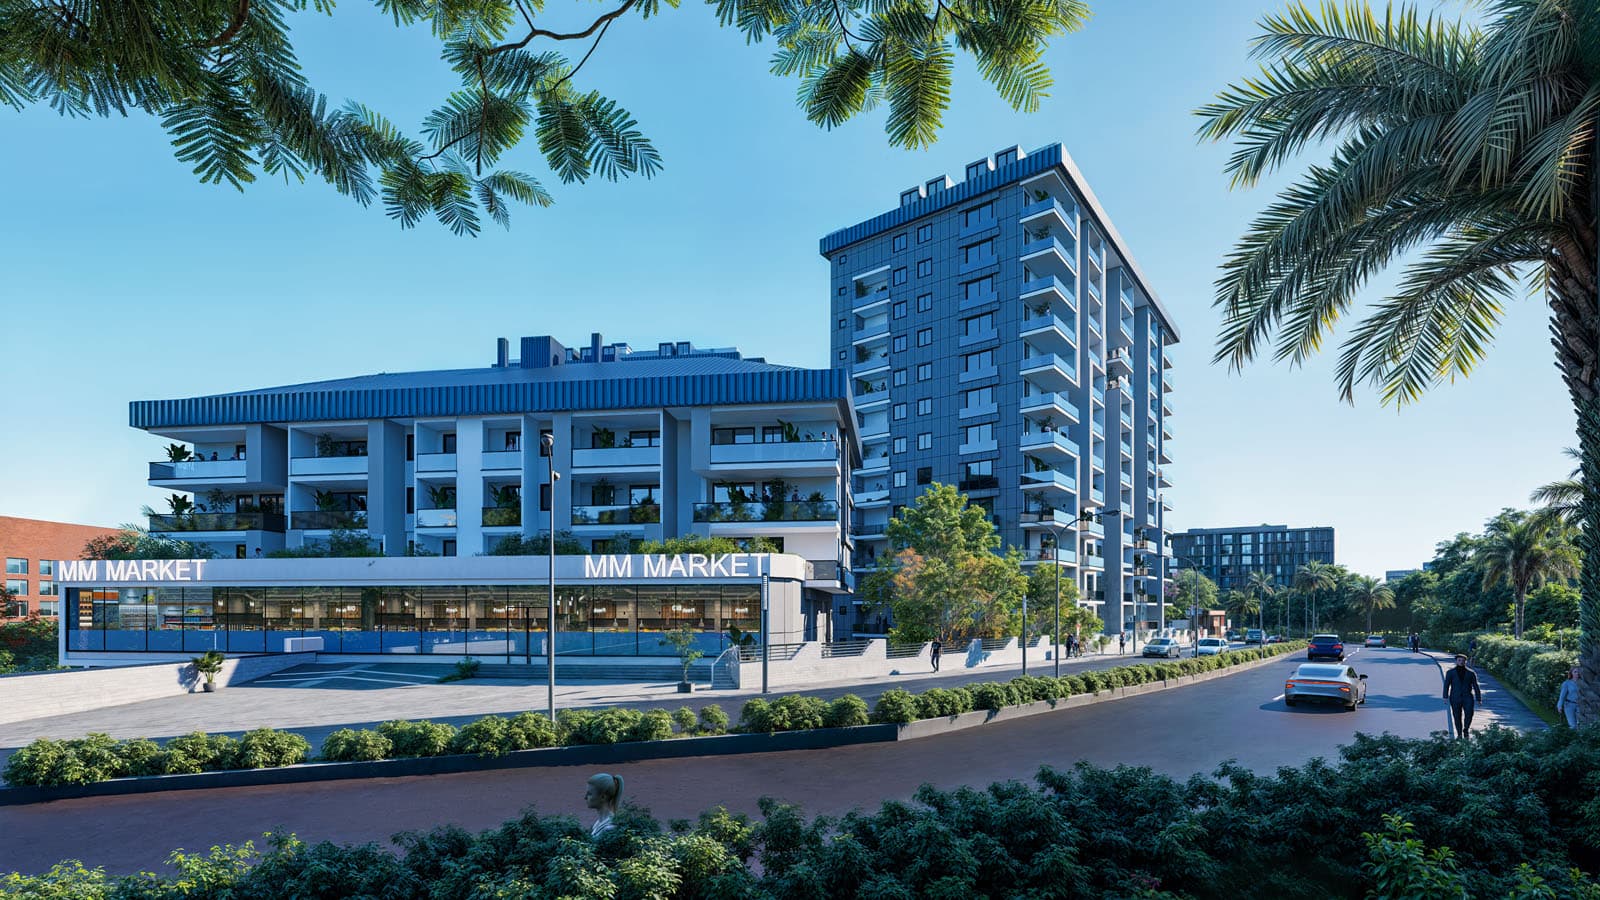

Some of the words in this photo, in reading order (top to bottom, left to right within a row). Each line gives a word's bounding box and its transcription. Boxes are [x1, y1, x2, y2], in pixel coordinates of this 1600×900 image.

[58, 560, 97, 581] MM
[105, 559, 207, 581] MARKET
[584, 555, 632, 578] MM
[643, 553, 769, 577] MARKET
